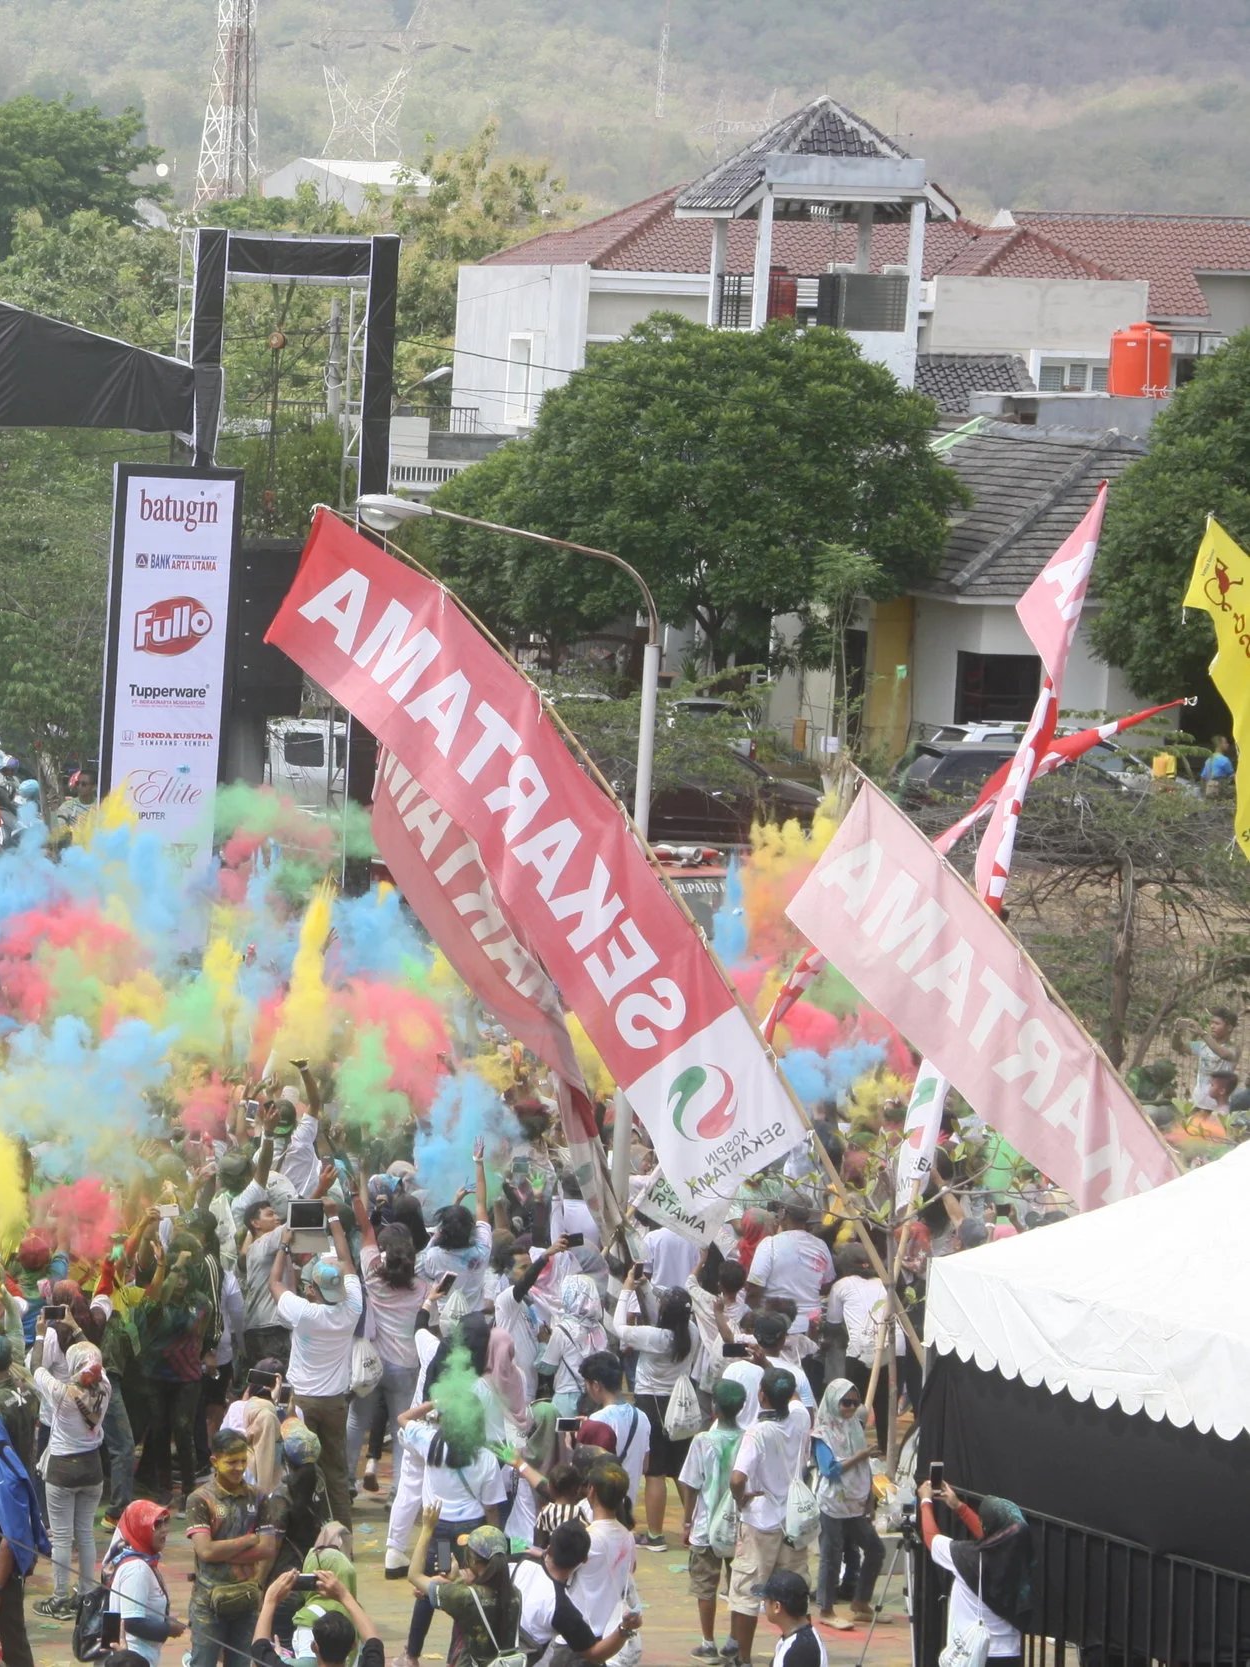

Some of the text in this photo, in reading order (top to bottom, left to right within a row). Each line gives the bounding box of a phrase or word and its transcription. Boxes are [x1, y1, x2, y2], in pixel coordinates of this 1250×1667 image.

[140, 489, 218, 532] batugin
[150, 553, 217, 571] BANK ARTA UTAMA
[135, 604, 212, 648] Fullo
[173, 732, 214, 740] KUSUMA
